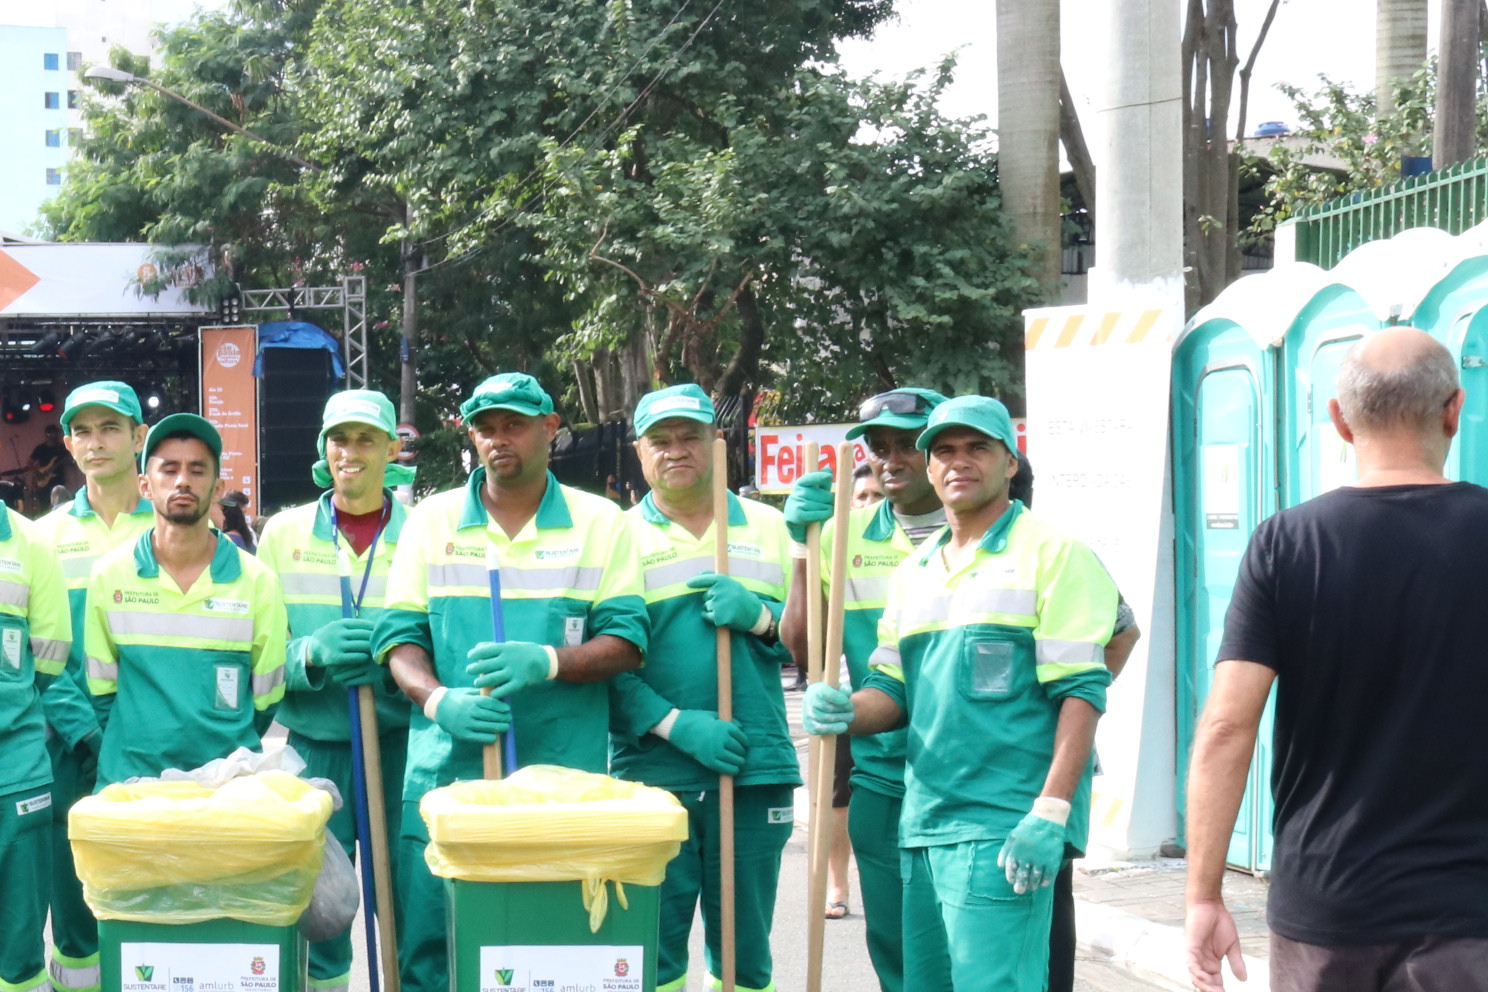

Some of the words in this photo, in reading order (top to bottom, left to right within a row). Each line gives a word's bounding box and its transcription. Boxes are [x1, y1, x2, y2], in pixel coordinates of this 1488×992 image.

[760, 434, 837, 485] Feia
[657, 552, 678, 563] PAULO
[124, 596, 136, 604] SÃO
[199, 981, 234, 990] amlurb
[560, 984, 596, 992] amlurb
